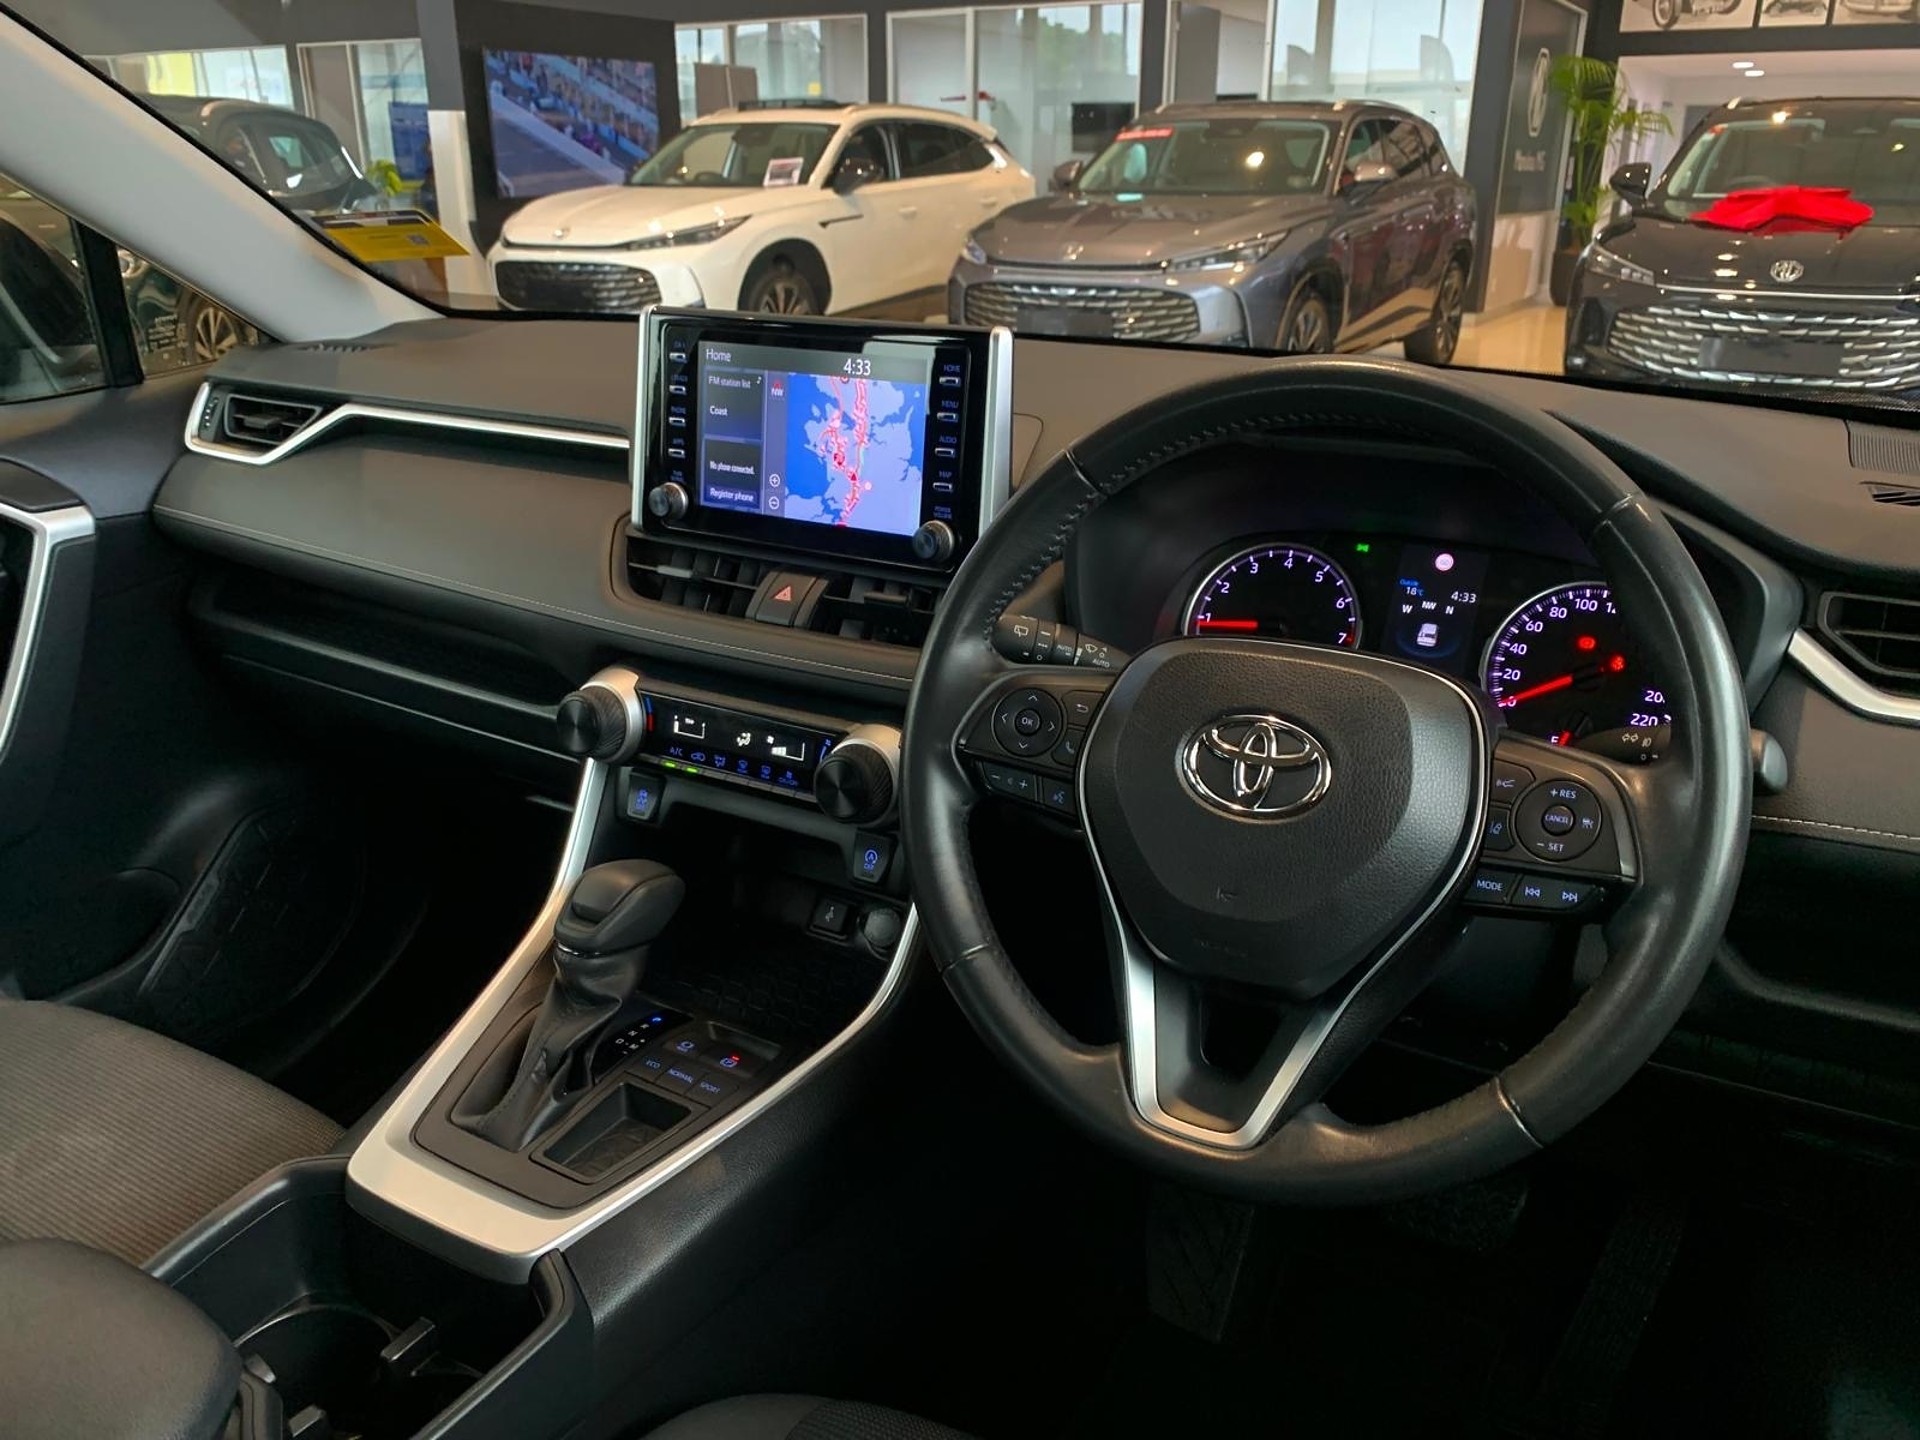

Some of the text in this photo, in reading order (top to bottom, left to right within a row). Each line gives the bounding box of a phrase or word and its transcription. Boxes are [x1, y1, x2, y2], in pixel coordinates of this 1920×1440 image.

[705, 348, 731, 362] Home
[843, 358, 871, 376] 4:33
[708, 376, 720, 385] FM
[720, 378, 741, 388] station
[709, 405, 728, 416] Coast
[717, 462, 731, 472] phone
[709, 486, 754, 502] Register phone
[1250, 562, 1259, 574] 3
[1284, 558, 1293, 570] 4
[1314, 571, 1324, 583] 5
[1220, 582, 1230, 594] 2
[1336, 597, 1345, 609] 6
[1451, 590, 1477, 604] 4:33
[1402, 600, 1454, 615] W NW N
[1574, 598, 1598, 611] 100
[1549, 606, 1568, 618] 80
[1525, 621, 1544, 632] 60
[1337, 632, 1347, 644] 7
[1509, 643, 1527, 655] 40
[1503, 668, 1521, 681] 20
[1021, 716, 1034, 727] OK
[669, 746, 683, 757] A/C
[1559, 789, 1576, 799] RES
[1545, 814, 1570, 825] CANCEL
[1548, 843, 1565, 853] SET
[1476, 879, 1503, 891] MODE
[667, 1067, 694, 1084] NORMAL
[700, 1081, 721, 1094] SPORT
